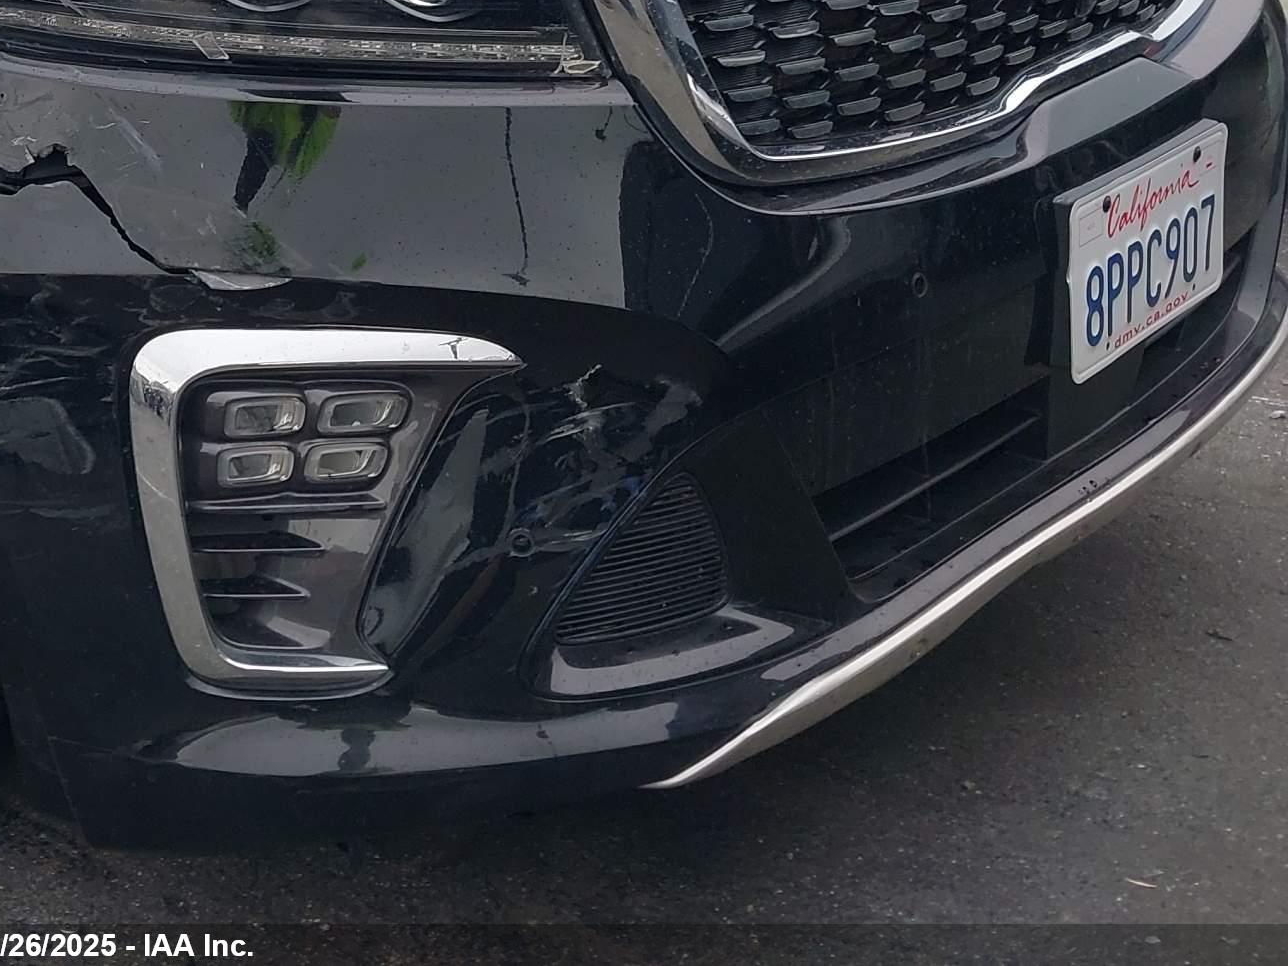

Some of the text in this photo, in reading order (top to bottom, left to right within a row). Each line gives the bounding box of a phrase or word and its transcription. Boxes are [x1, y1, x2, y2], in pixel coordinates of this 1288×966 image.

[1106, 164, 1199, 238] California
[1086, 194, 1215, 347] 8PPC907
[1113, 291, 1189, 349] dmv.ca.gov
